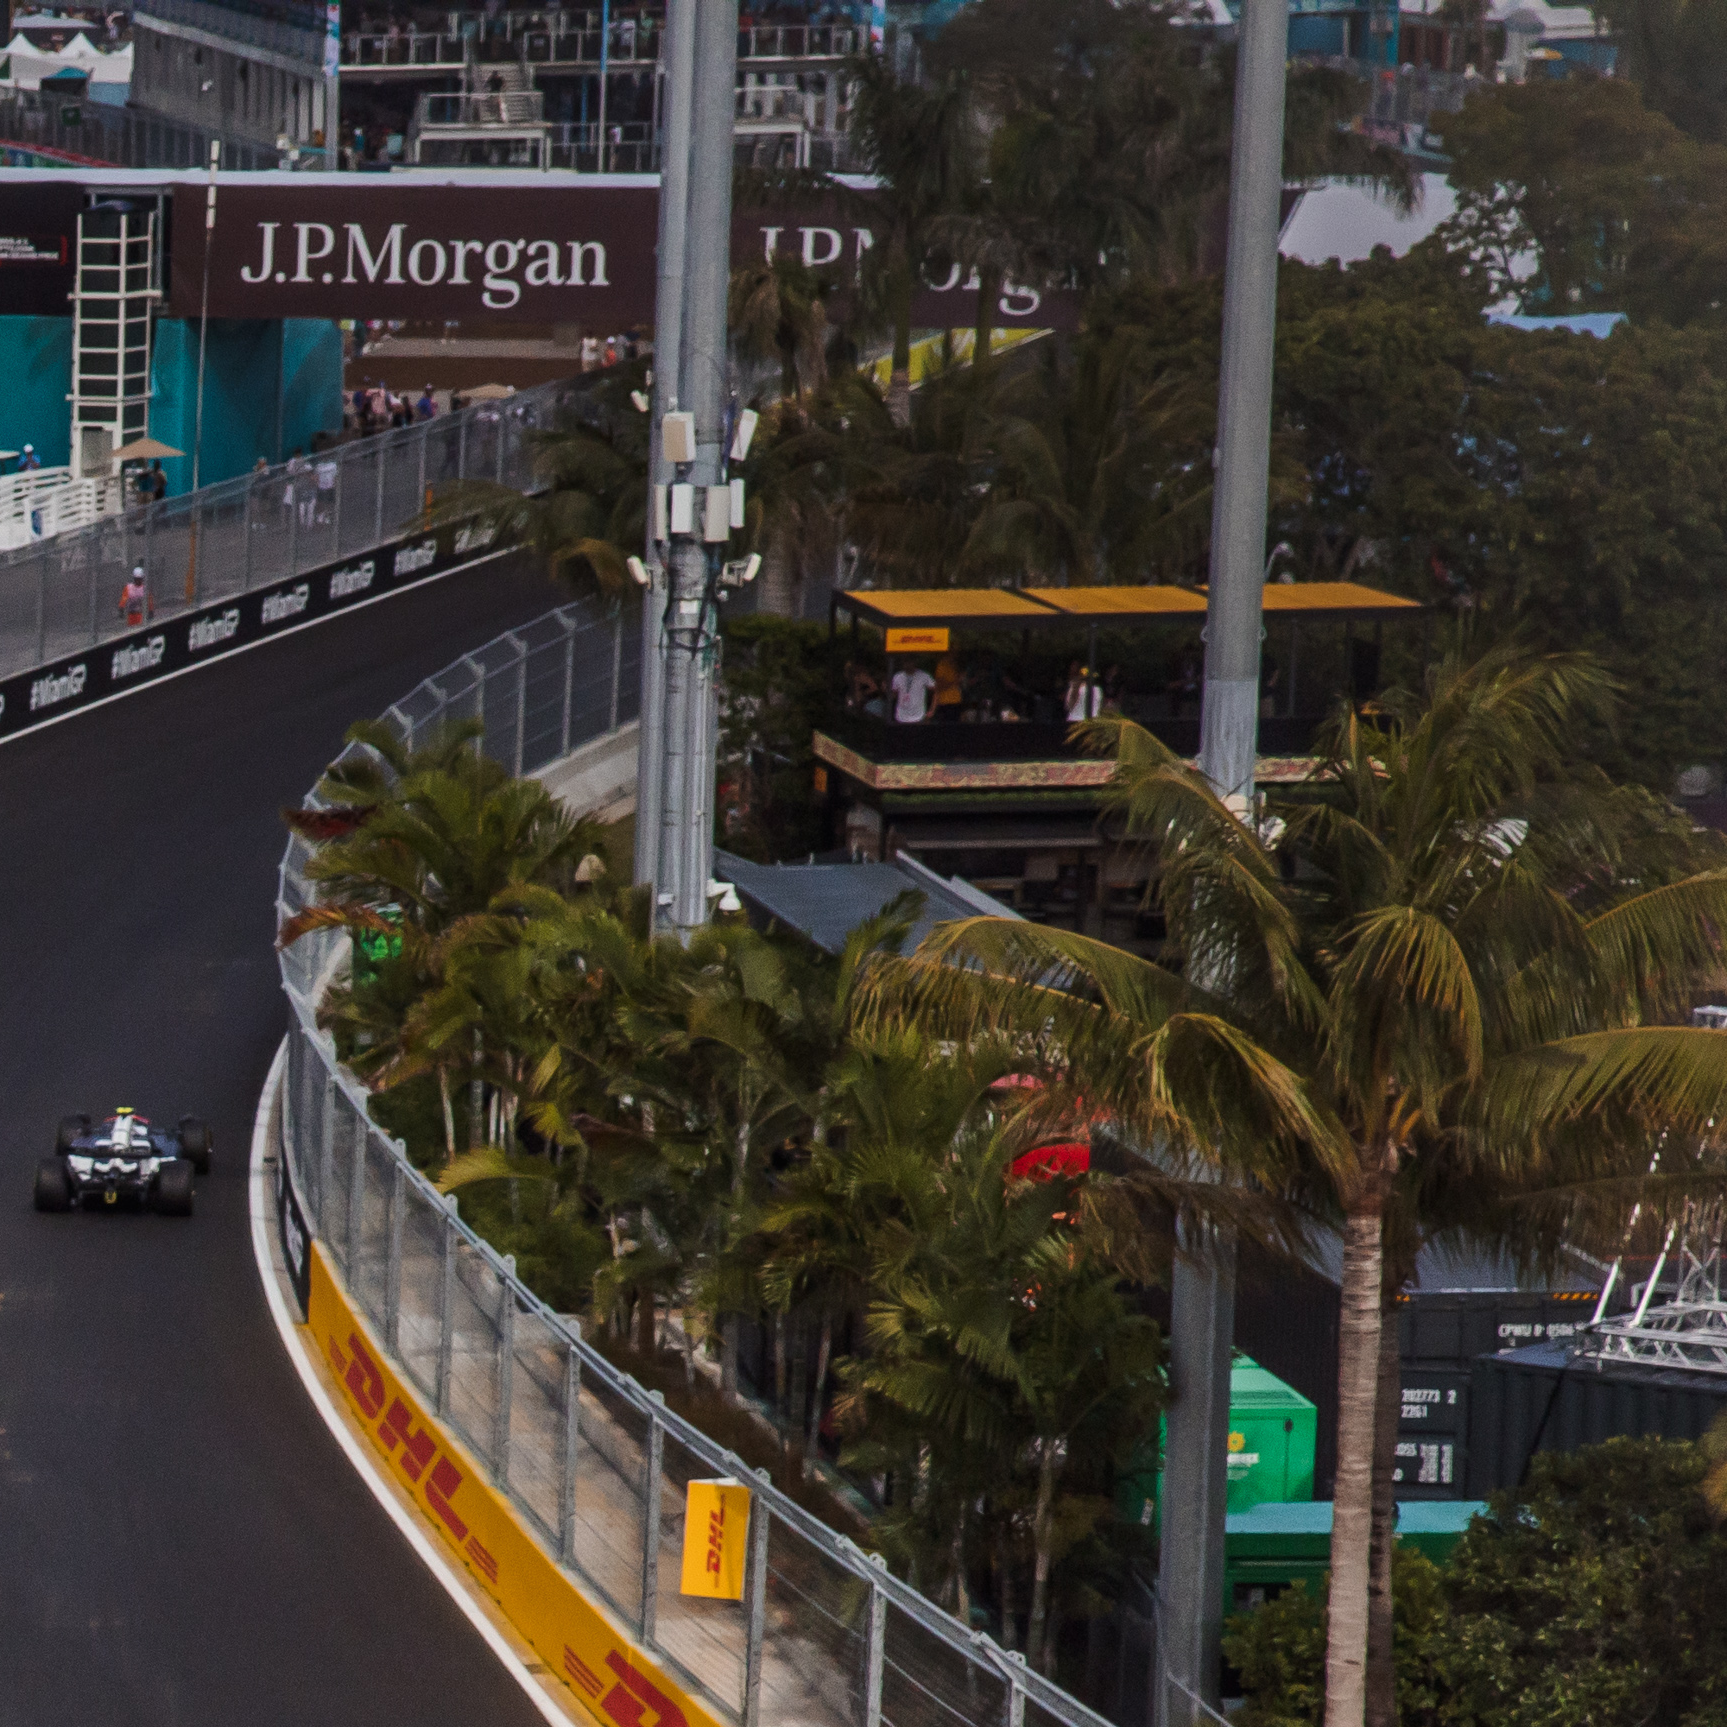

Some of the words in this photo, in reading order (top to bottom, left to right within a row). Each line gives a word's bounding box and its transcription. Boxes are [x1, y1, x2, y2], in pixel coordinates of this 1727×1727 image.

[241, 222, 610, 309] J.P.Morgan
[345, 1333, 469, 1541] DHL
[707, 1508, 726, 1573] DHL
